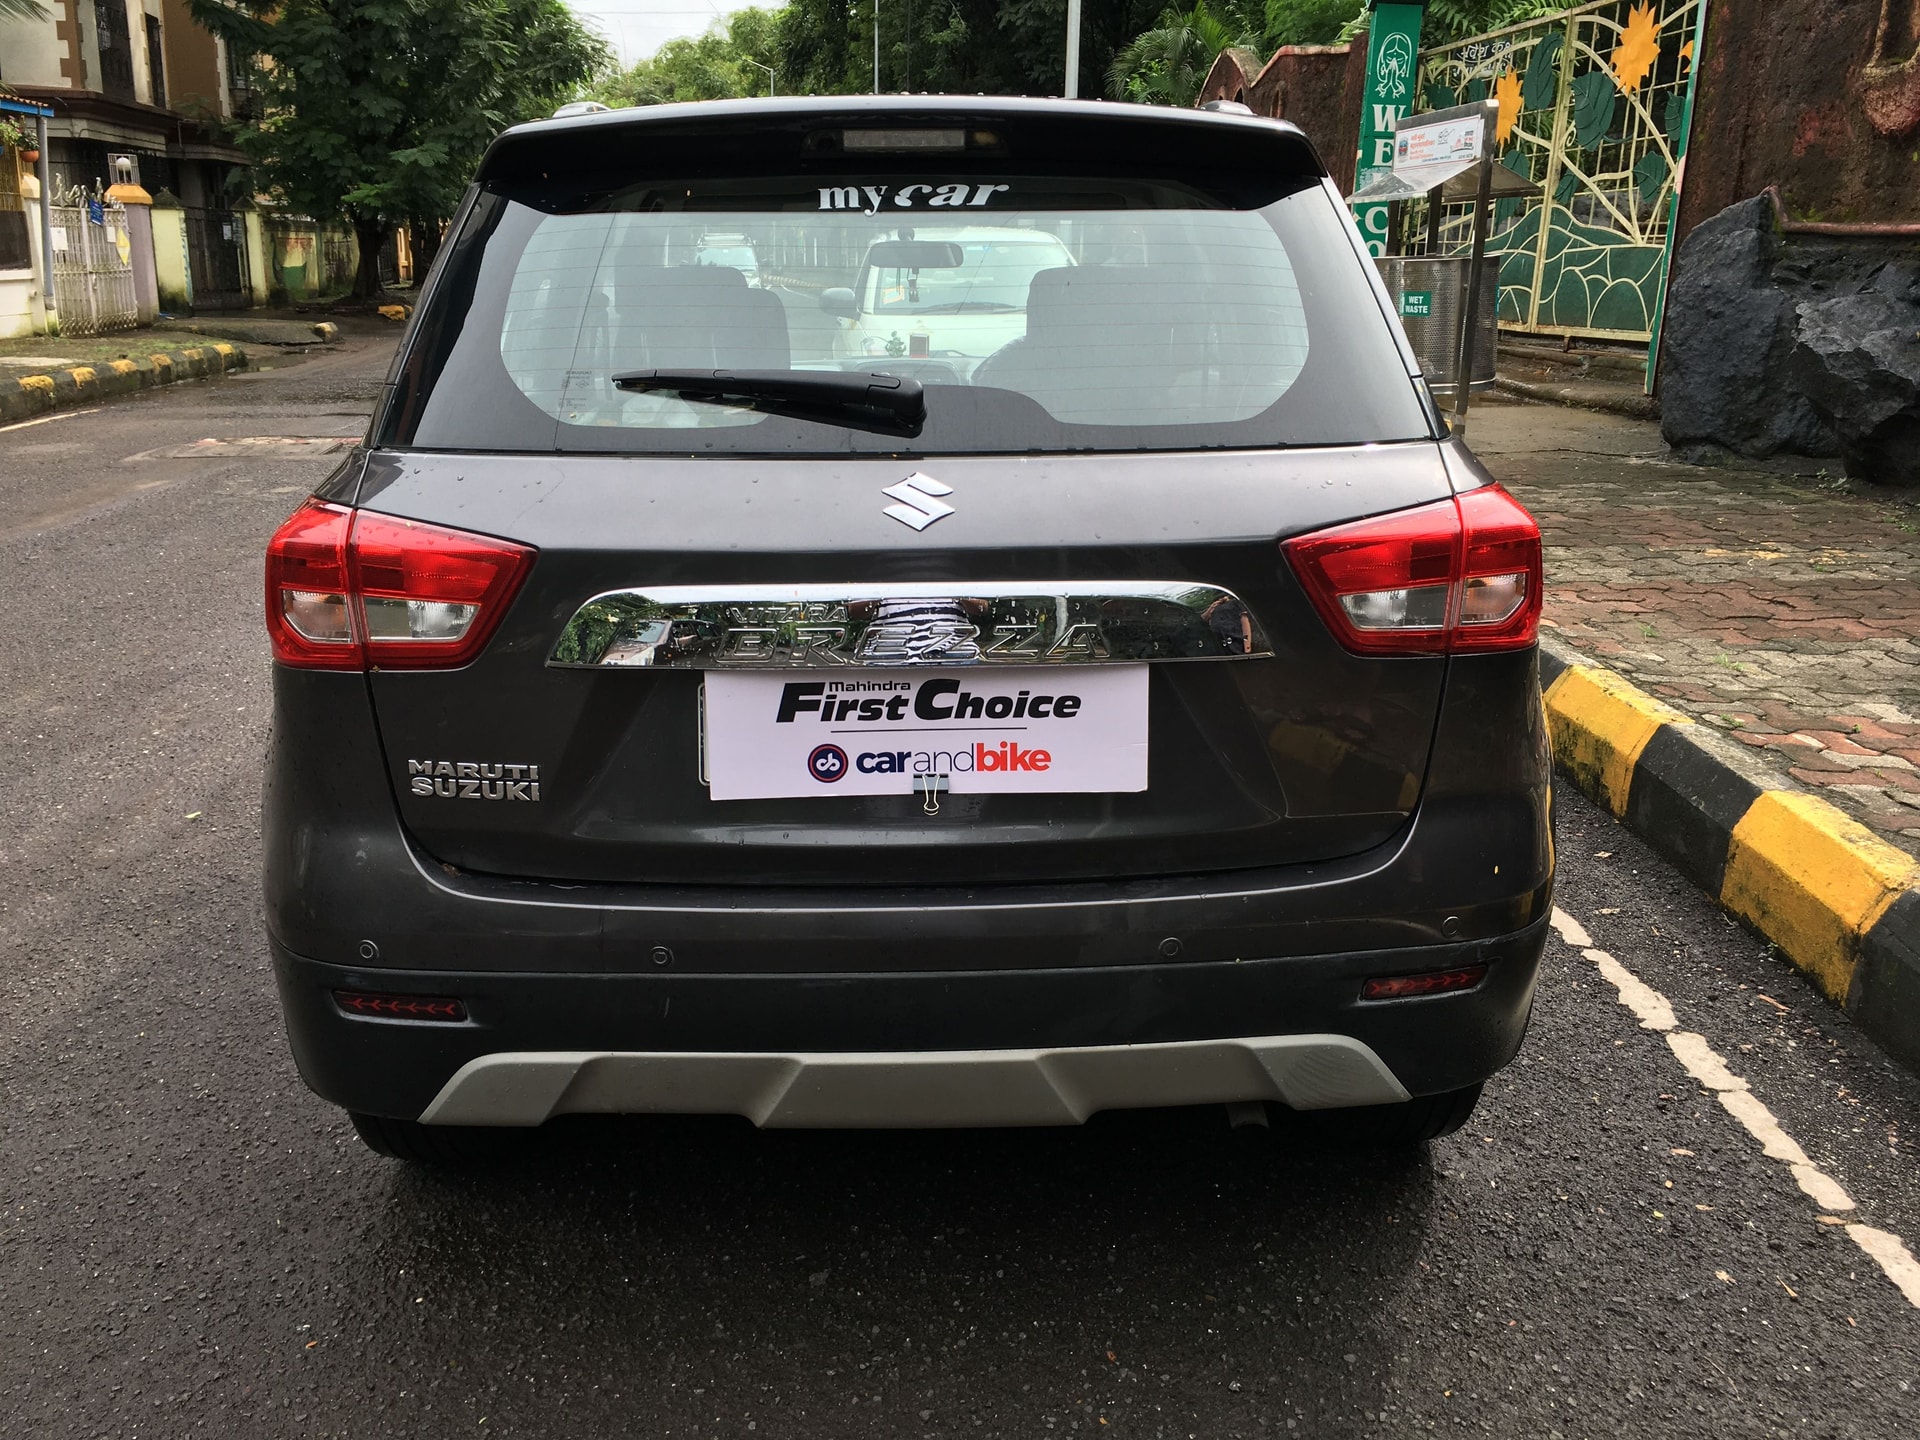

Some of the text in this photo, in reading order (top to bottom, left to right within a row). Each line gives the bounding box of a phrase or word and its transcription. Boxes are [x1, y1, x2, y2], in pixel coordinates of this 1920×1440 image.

[1405, 305, 1428, 314] WASTE
[1408, 295, 1424, 304] WET
[729, 604, 849, 624] VITARA
[714, 624, 1112, 663] BREZZA
[829, 680, 911, 692] Mahindra
[776, 678, 1082, 723] First Choice
[856, 741, 1052, 774] carandbike
[408, 759, 539, 780] MARUTI
[411, 776, 541, 801] SUZUKI
